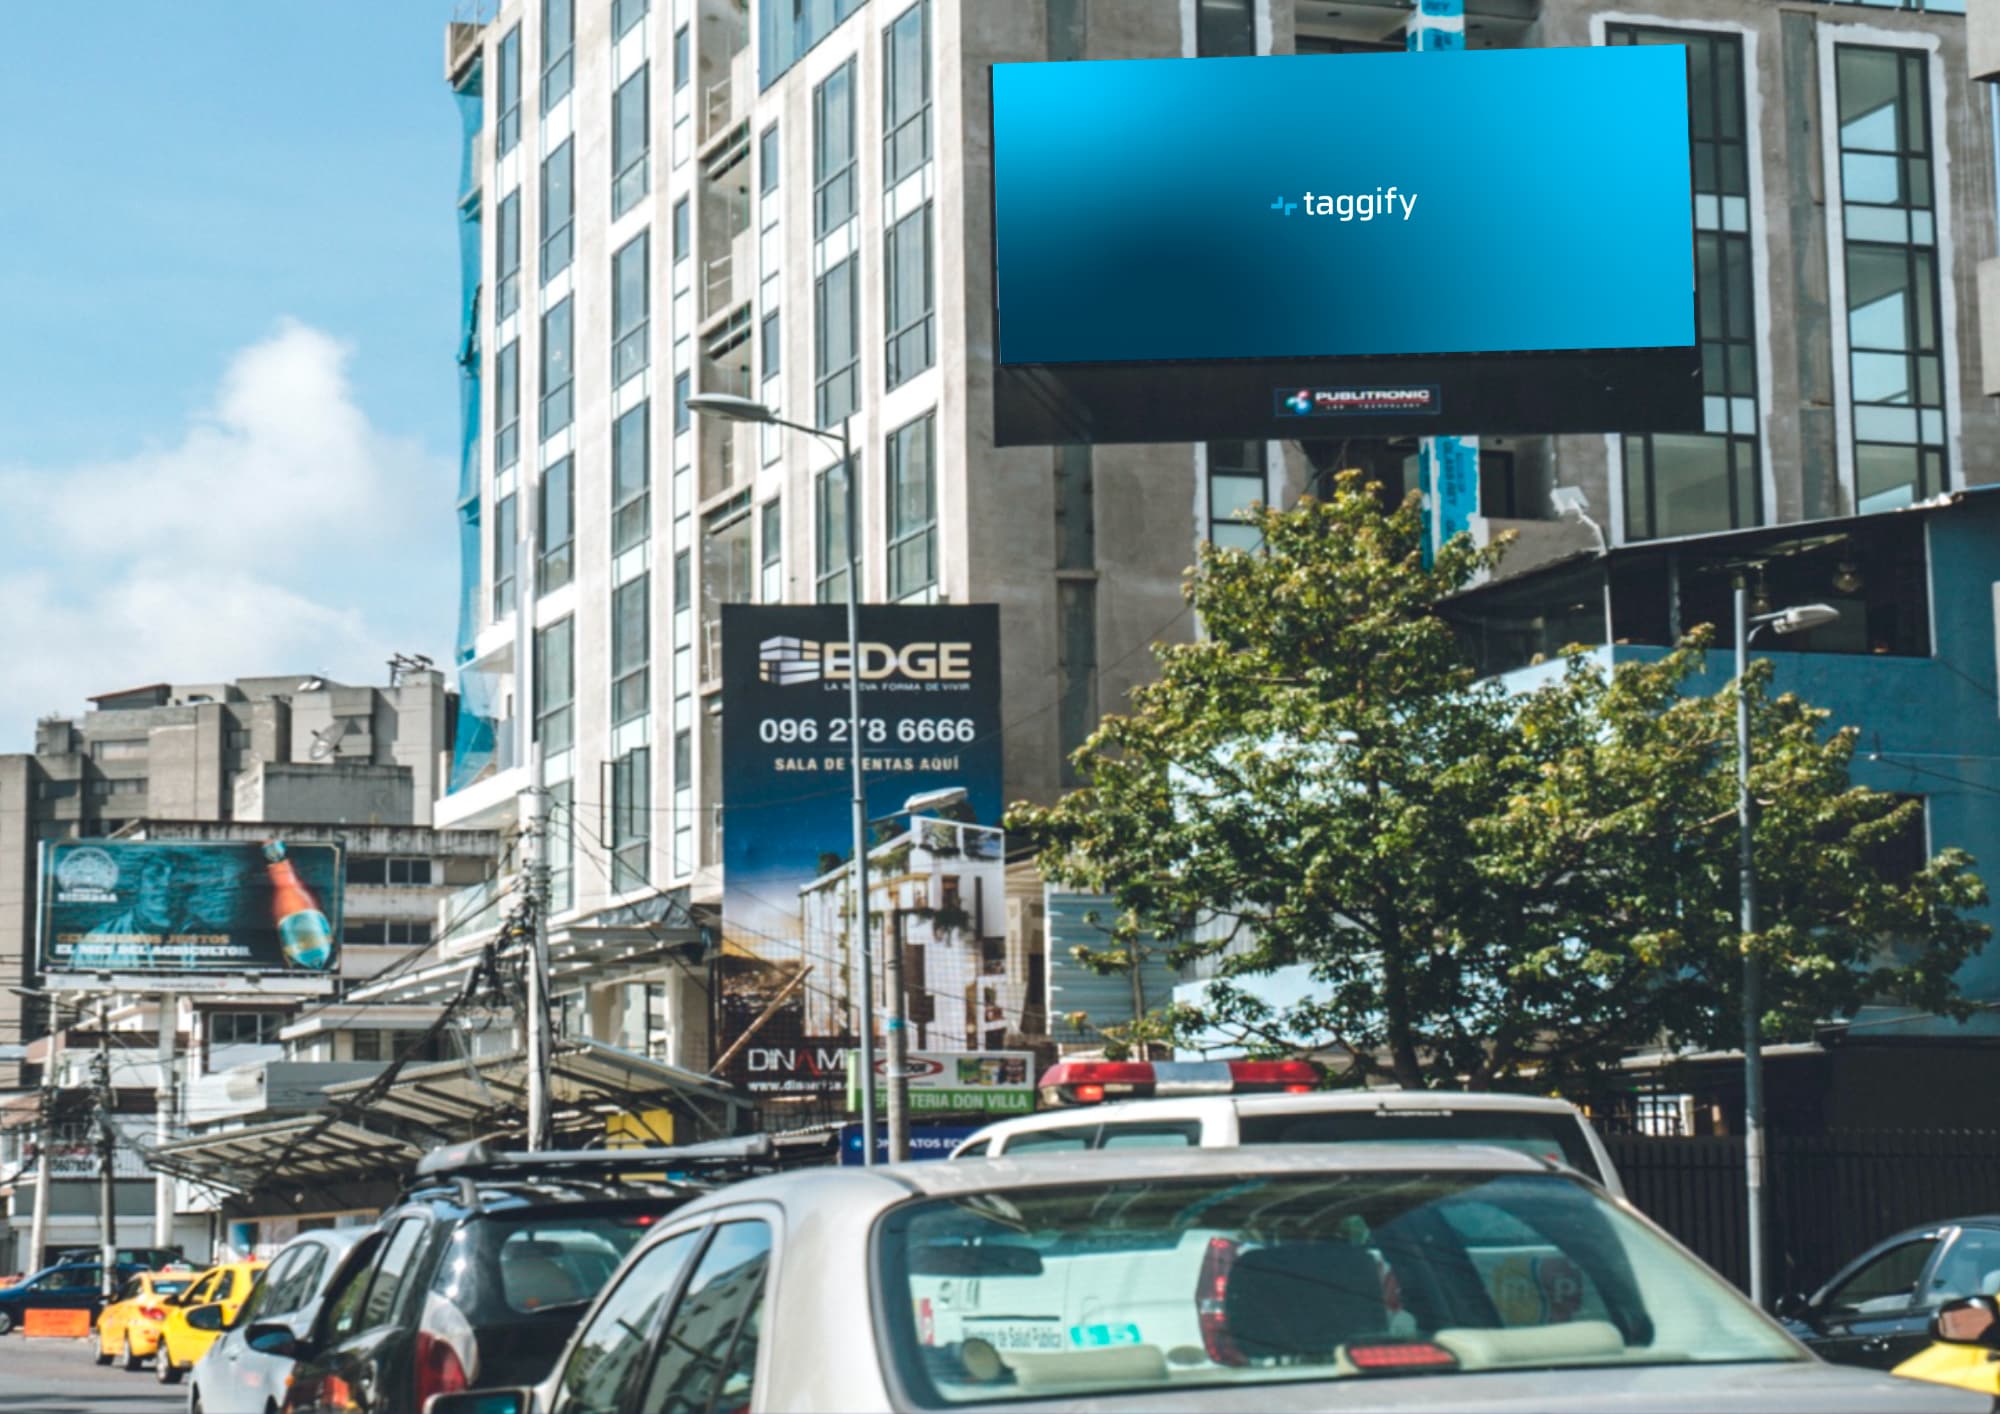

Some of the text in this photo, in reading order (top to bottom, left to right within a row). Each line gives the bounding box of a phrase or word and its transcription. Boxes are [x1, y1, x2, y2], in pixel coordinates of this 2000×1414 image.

[1303, 186, 1418, 221] taggify
[1314, 389, 1430, 401] PUBLITRONIC
[823, 642, 972, 680] EDGE
[824, 682, 838, 692] LA
[881, 682, 921, 692] FORMA
[924, 682, 939, 692] DE
[942, 682, 971, 692] VIVIR
[759, 718, 818, 744] 096
[897, 718, 975, 743] 6666
[774, 757, 817, 771] SALA
[824, 757, 845, 771] DE
[853, 757, 914, 771] ENTAS
[952, 1093, 983, 1108] DON
[986, 1092, 1027, 1108] VILLA
